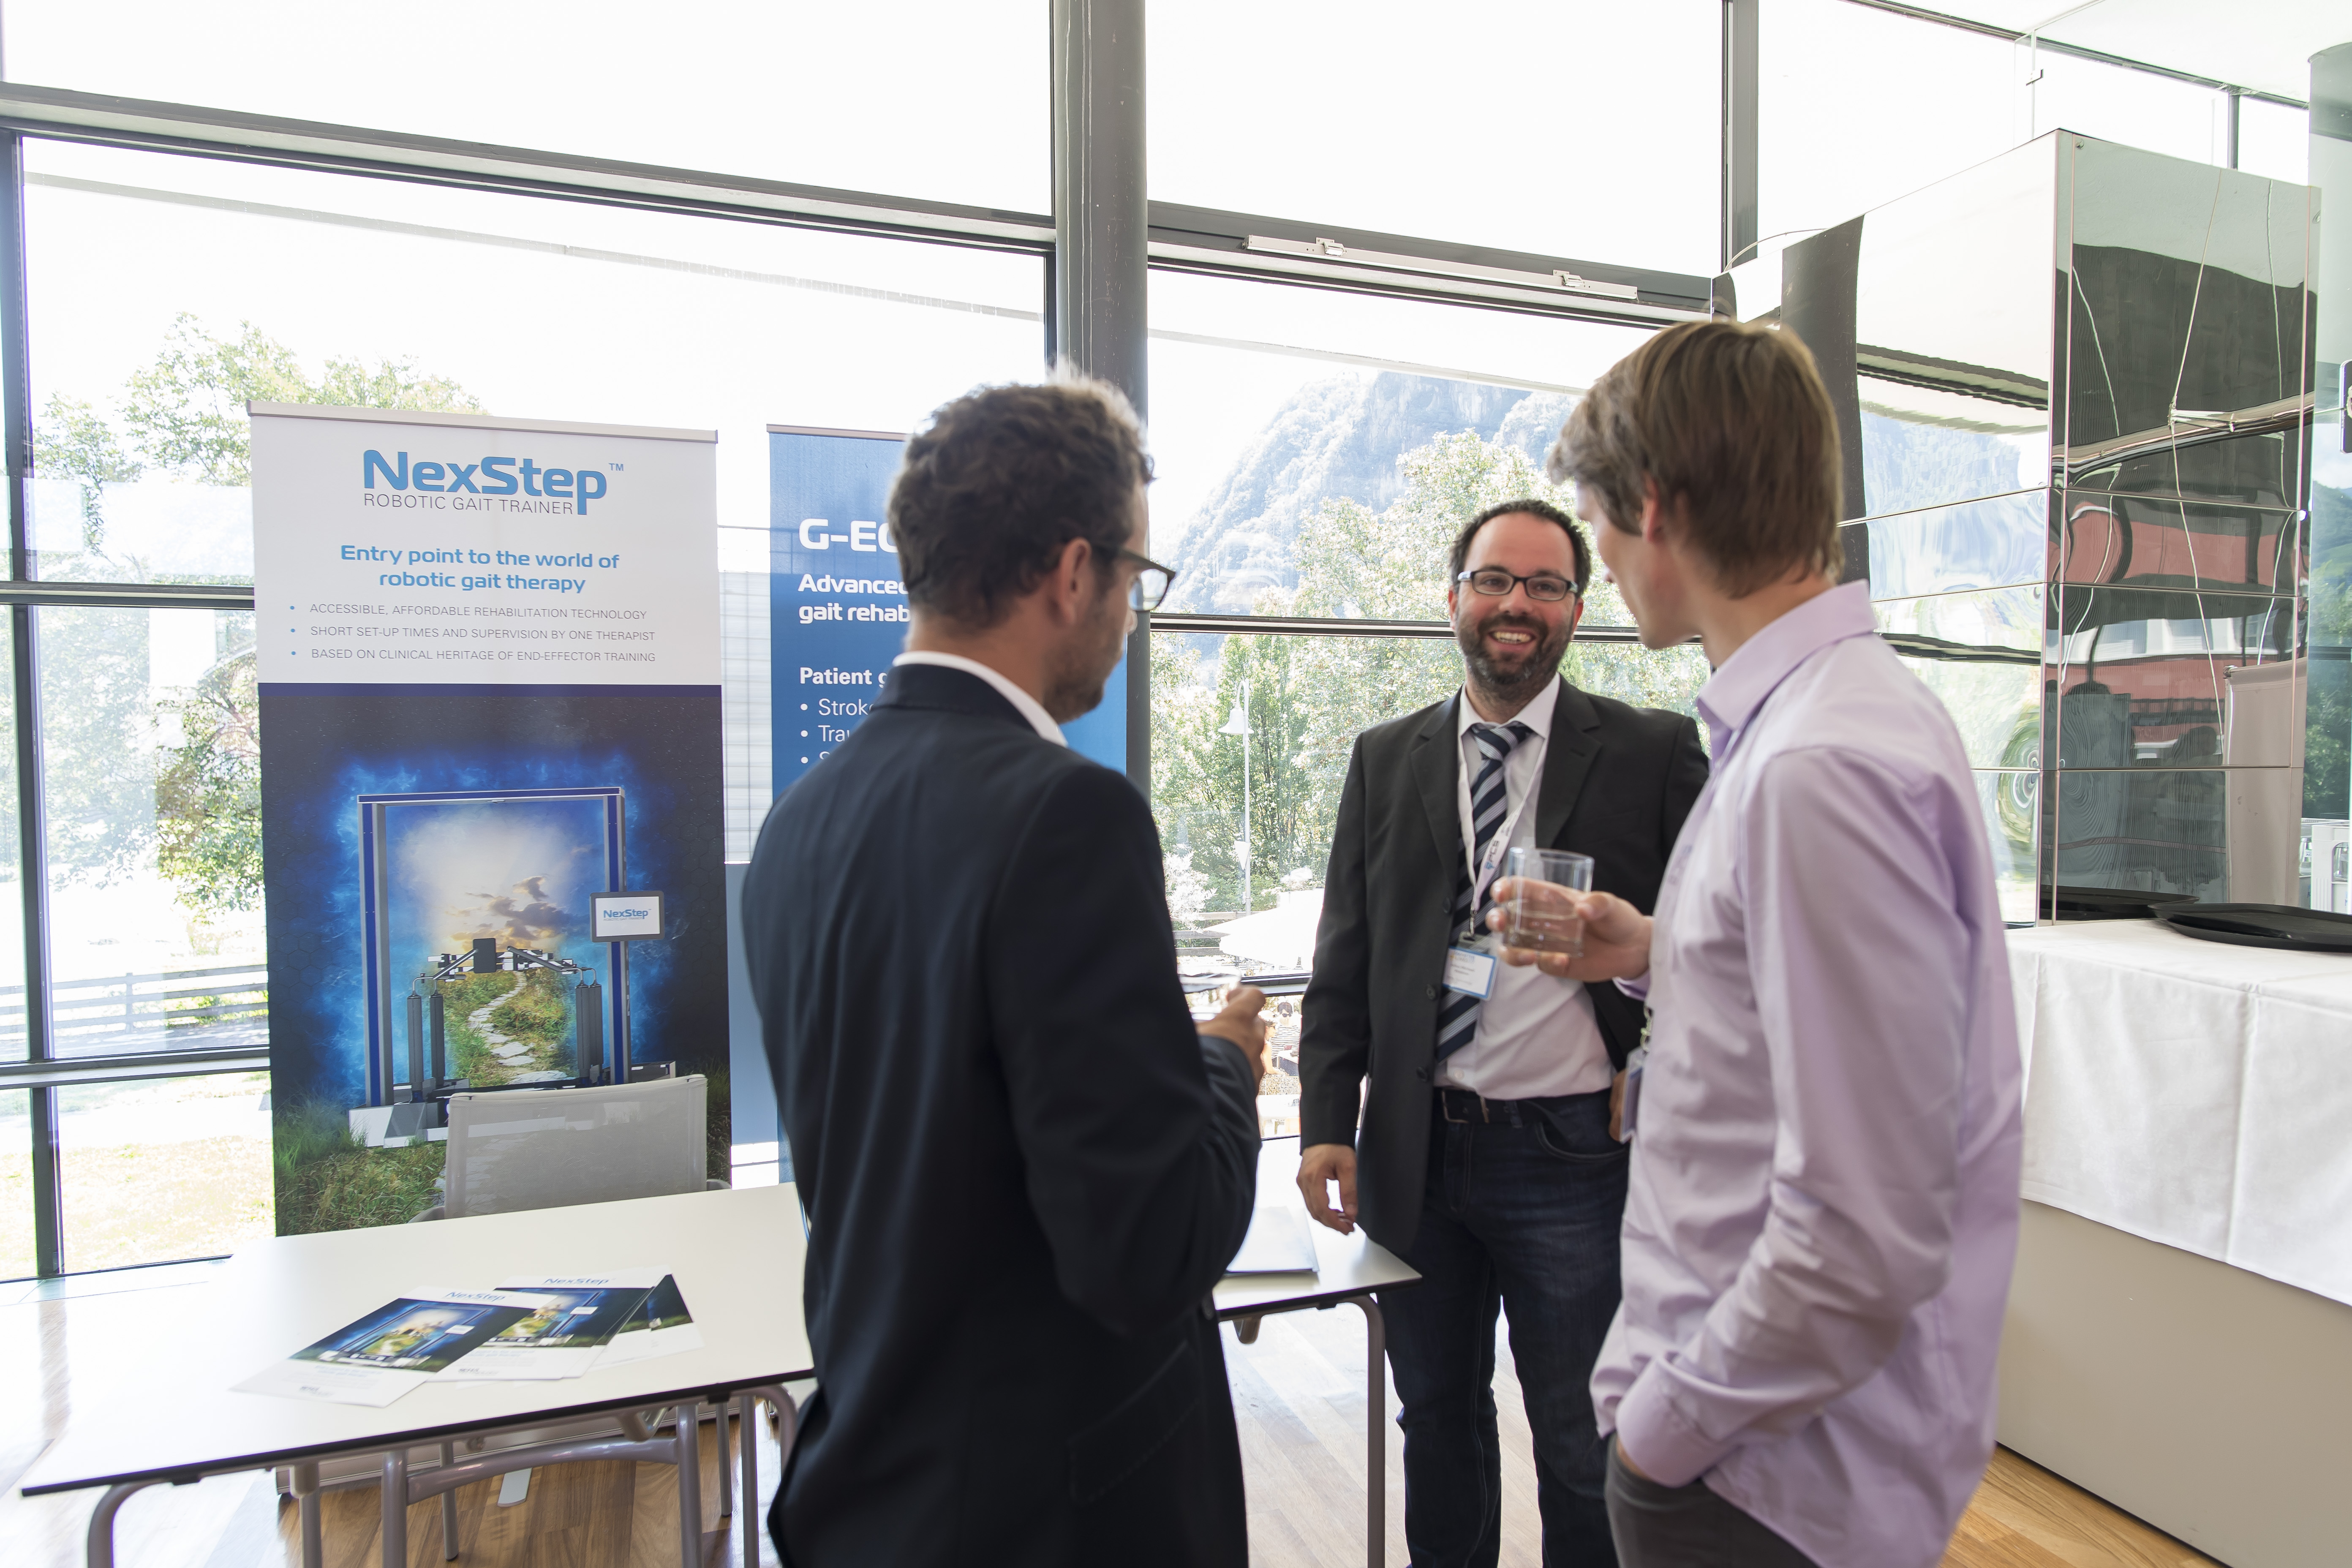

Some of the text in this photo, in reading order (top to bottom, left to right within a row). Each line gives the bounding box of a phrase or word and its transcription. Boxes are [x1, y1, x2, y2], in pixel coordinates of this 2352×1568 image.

[363, 449, 607, 515] NexStep
[364, 493, 573, 514] ROBOTIC GAIT TRAINER
[341, 545, 620, 569] Entry point to the world of
[380, 571, 585, 593] robotic gait therapy
[310, 604, 647, 619] ACCESSIBLE, AFFORDABLE REHABILITATION TECHNOLOGY
[799, 602, 843, 624] gait
[311, 626, 655, 640] SHORT SET-UP TIMES AND SUPERVISION BY ONE THERAPIST
[312, 649, 655, 662] BASED ON CLINICAL HERITAGE OF END-EFFECTOR TRAINING
[800, 667, 872, 685] Patient
[818, 698, 874, 716] Strok
[817, 725, 850, 742] Tra
[603, 909, 648, 920] NexStep
[542, 1277, 609, 1285] NexStep
[444, 1291, 506, 1302] NexStep
